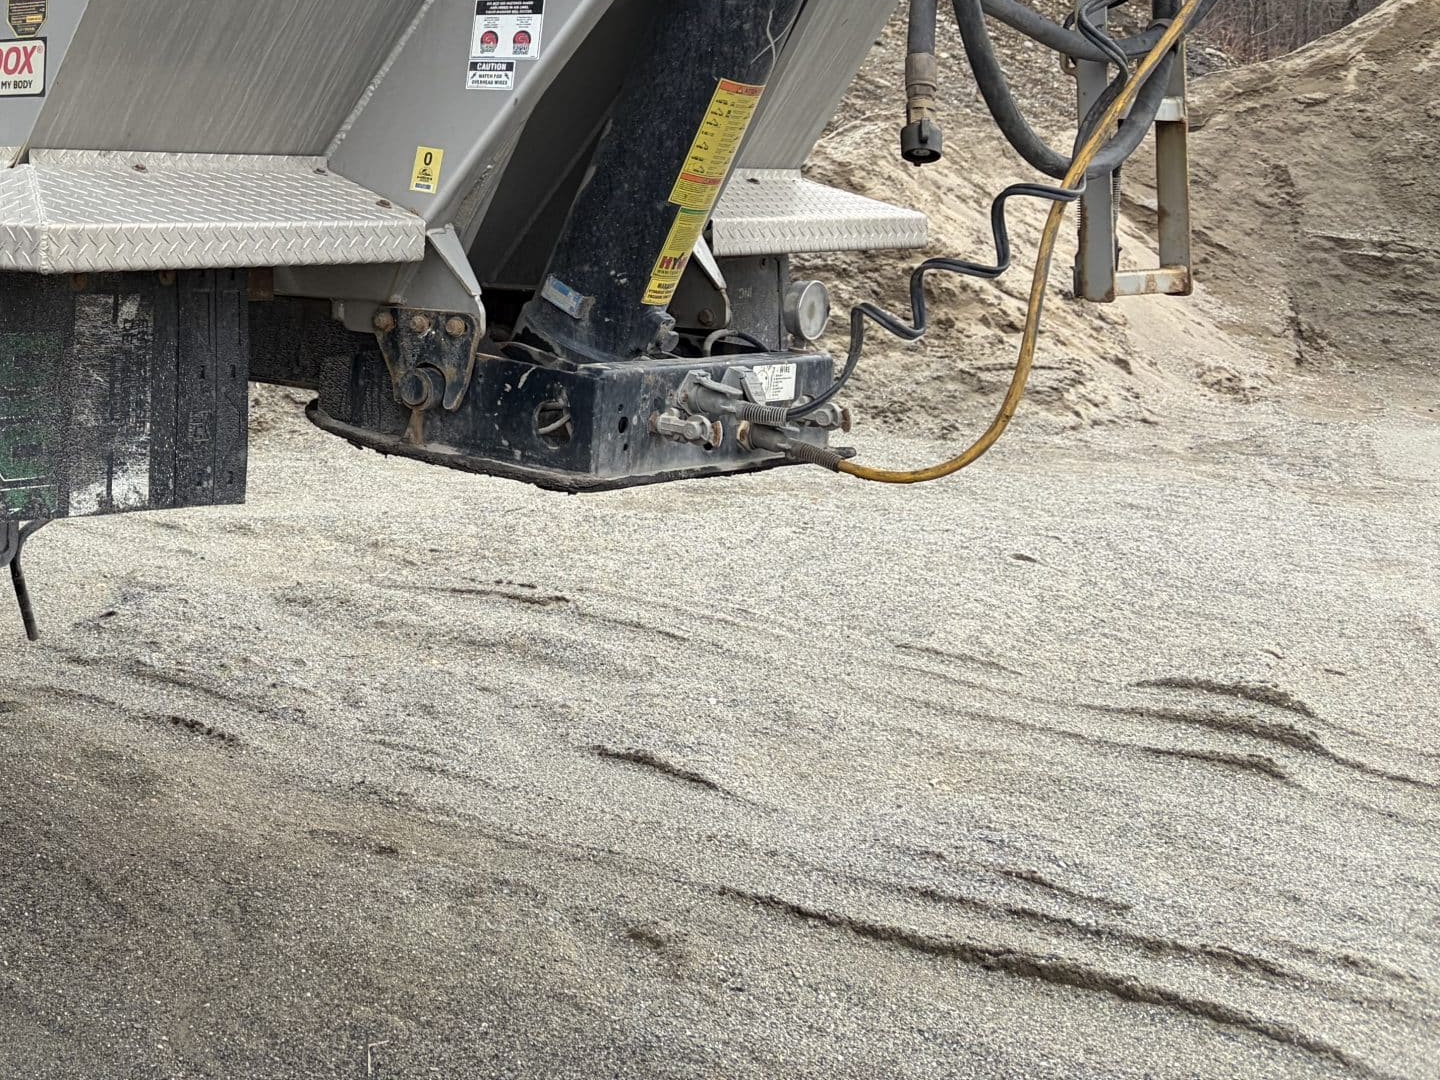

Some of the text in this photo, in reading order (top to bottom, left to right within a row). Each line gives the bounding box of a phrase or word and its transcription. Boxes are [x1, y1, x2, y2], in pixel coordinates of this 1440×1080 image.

[476, 62, 507, 71] CAUTION
[1, 80, 12, 90] MY
[13, 79, 33, 90] BODY
[423, 151, 433, 166] 0
